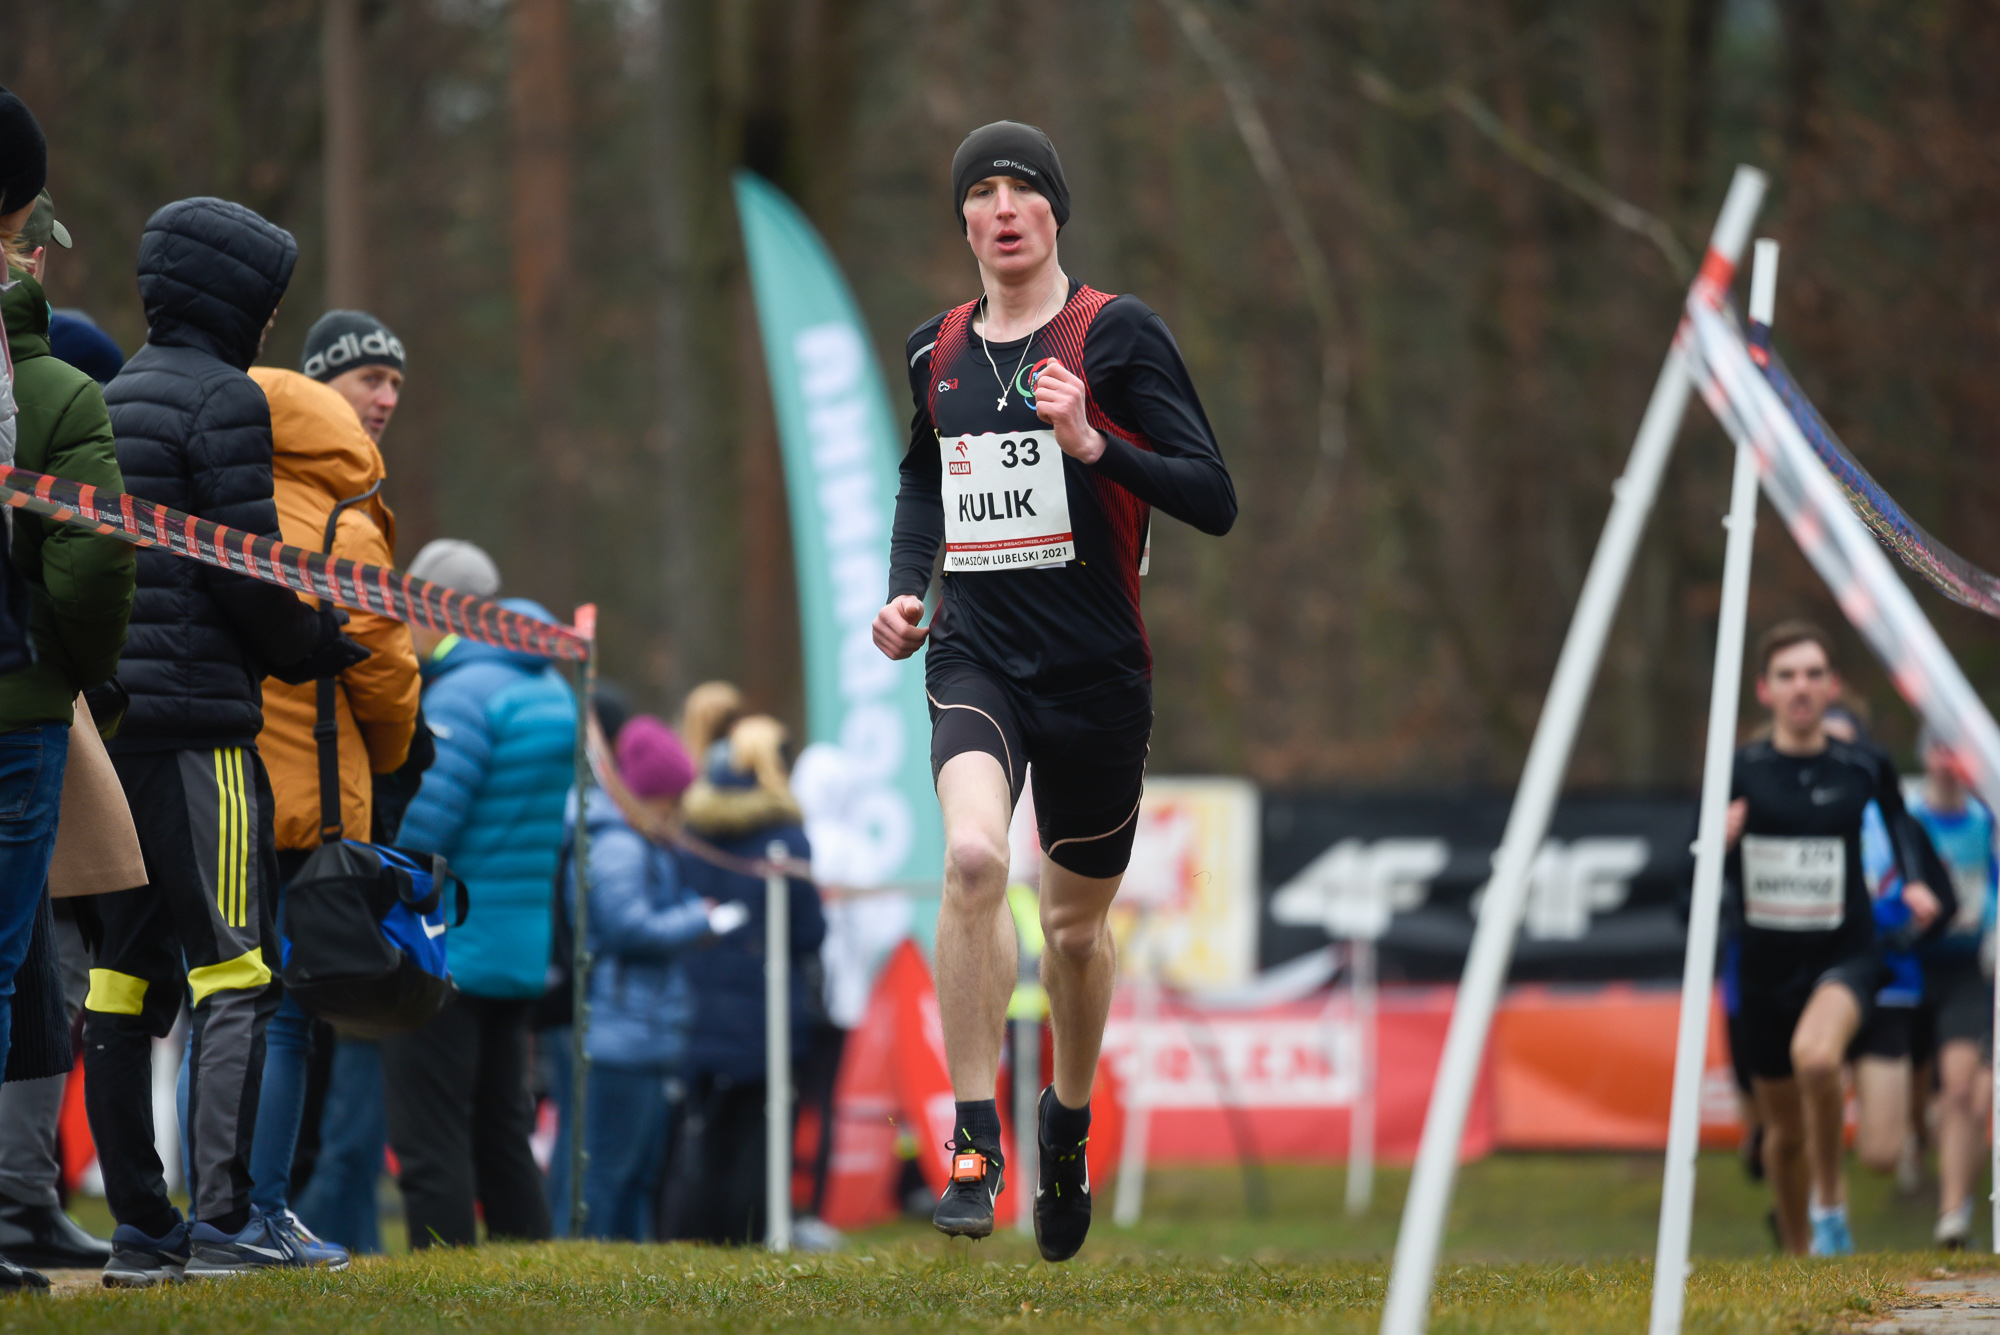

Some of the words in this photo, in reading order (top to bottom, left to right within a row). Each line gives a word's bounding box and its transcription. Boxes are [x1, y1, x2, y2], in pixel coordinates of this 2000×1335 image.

[950, 462, 970, 474] ORLEN
[1000, 437, 1041, 468] 33
[959, 488, 1037, 522] KULIK
[951, 554, 989, 566] TOMASZÓW
[992, 551, 1039, 565] LUBELSKI
[1042, 547, 1067, 559] 2021
[1270, 835, 1450, 940] 4F
